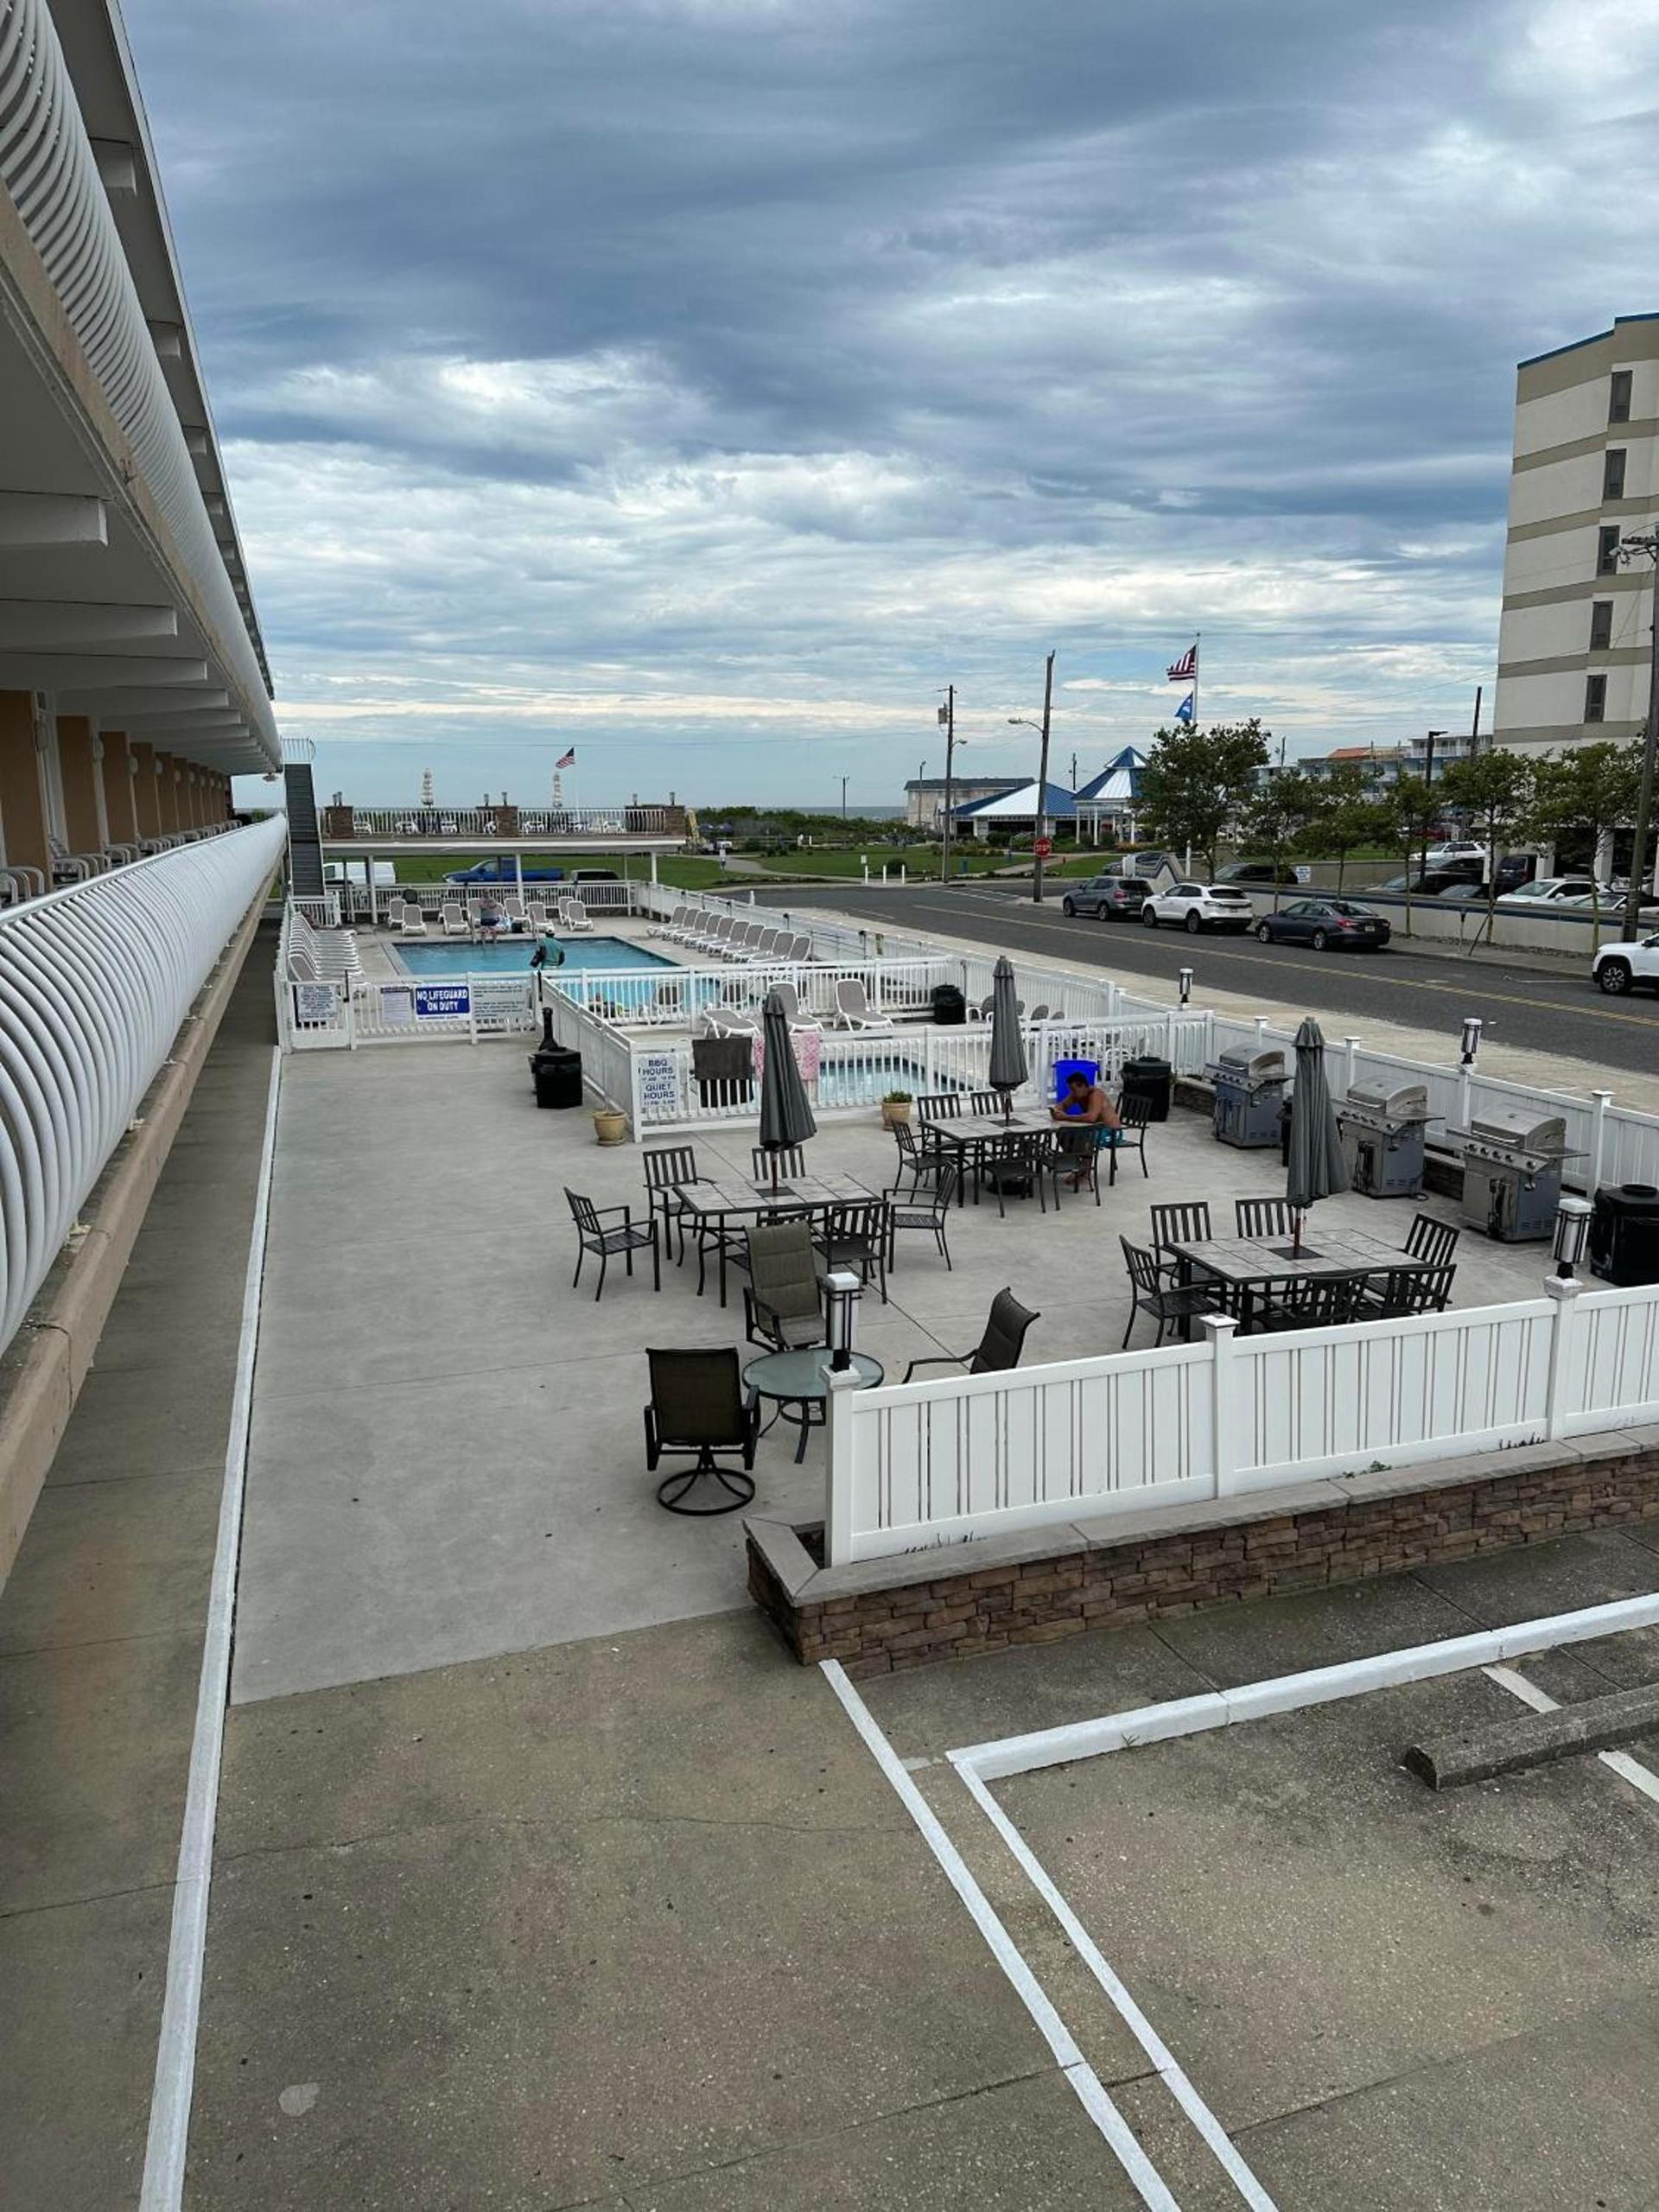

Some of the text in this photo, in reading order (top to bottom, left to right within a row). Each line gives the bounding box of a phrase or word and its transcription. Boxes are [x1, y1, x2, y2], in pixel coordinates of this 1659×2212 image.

[416, 990, 429, 1001] NO
[429, 989, 468, 1000] LIFEGUARD
[427, 1001, 459, 1011] ON DUTY
[642, 1066, 674, 1076] HOURS
[645, 1083, 671, 1091] QUIET
[644, 1090, 675, 1100] HOURS
